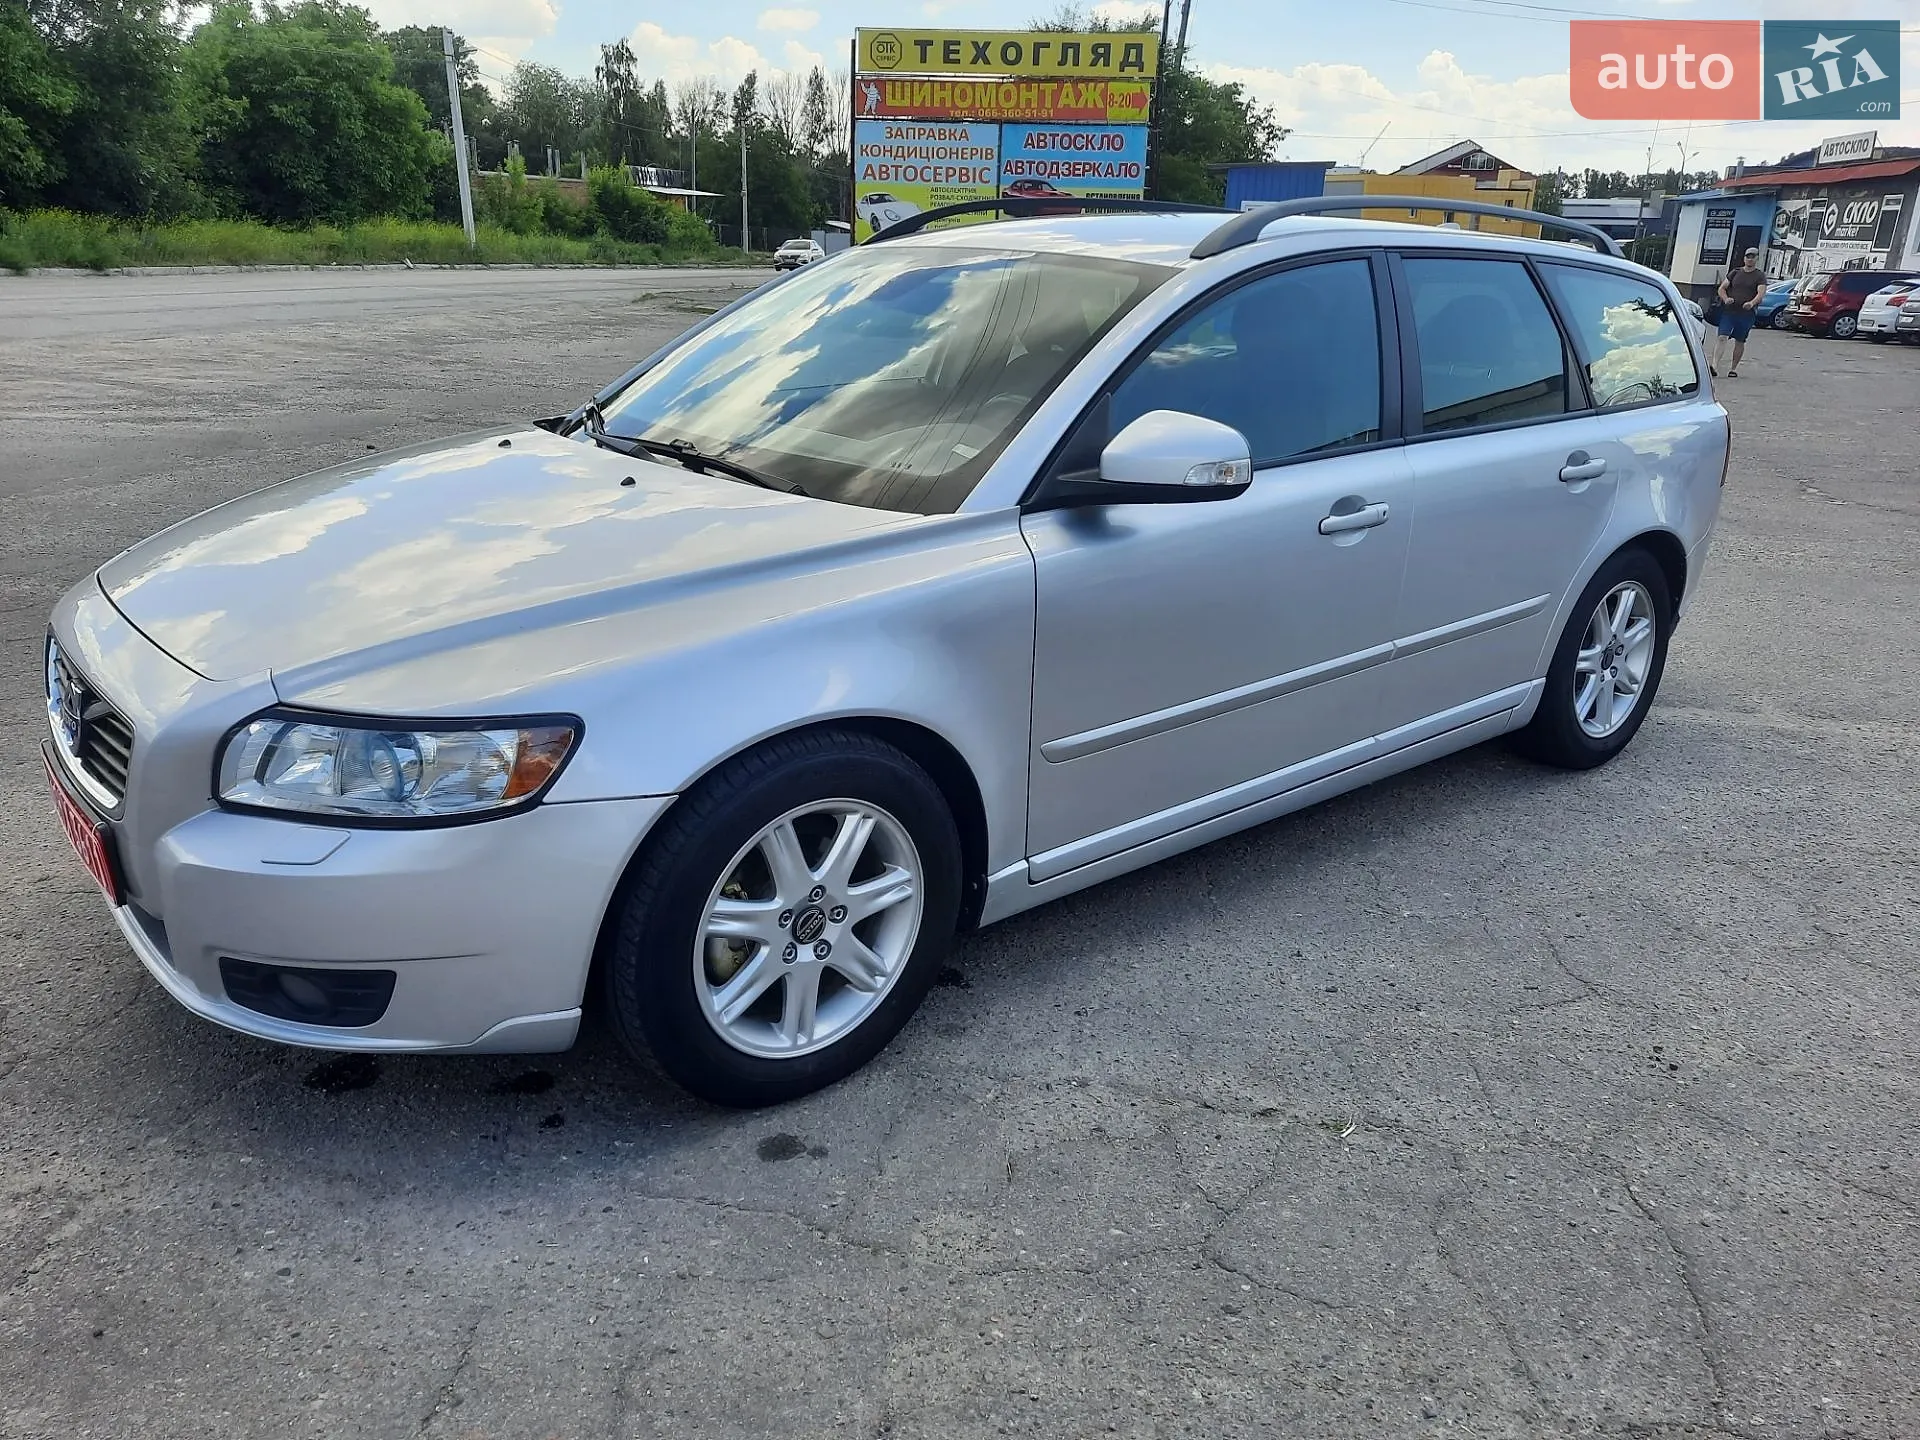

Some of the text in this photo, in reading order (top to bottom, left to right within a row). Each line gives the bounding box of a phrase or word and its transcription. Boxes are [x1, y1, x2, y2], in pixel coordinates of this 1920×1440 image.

[914, 40, 1145, 72] ТЕХОГЛЯД
[885, 81, 1105, 108] ШИНОМОНТАЖ
[884, 126, 970, 141] ЗАПРАВКА
[1023, 132, 1124, 151] АВТОСКЛО
[860, 144, 995, 162] КОНДИЦІОНЕРІВ
[1823, 138, 1870, 157] АВТОСКЛО
[862, 163, 991, 184] АВТОСЕРВІС
[1002, 159, 1140, 179] АВТОДЗЕРКАЛО
[1843, 201, 1879, 224] СКЛО
[1834, 225, 1860, 237] market
[800, 914, 823, 940] VOLVO
